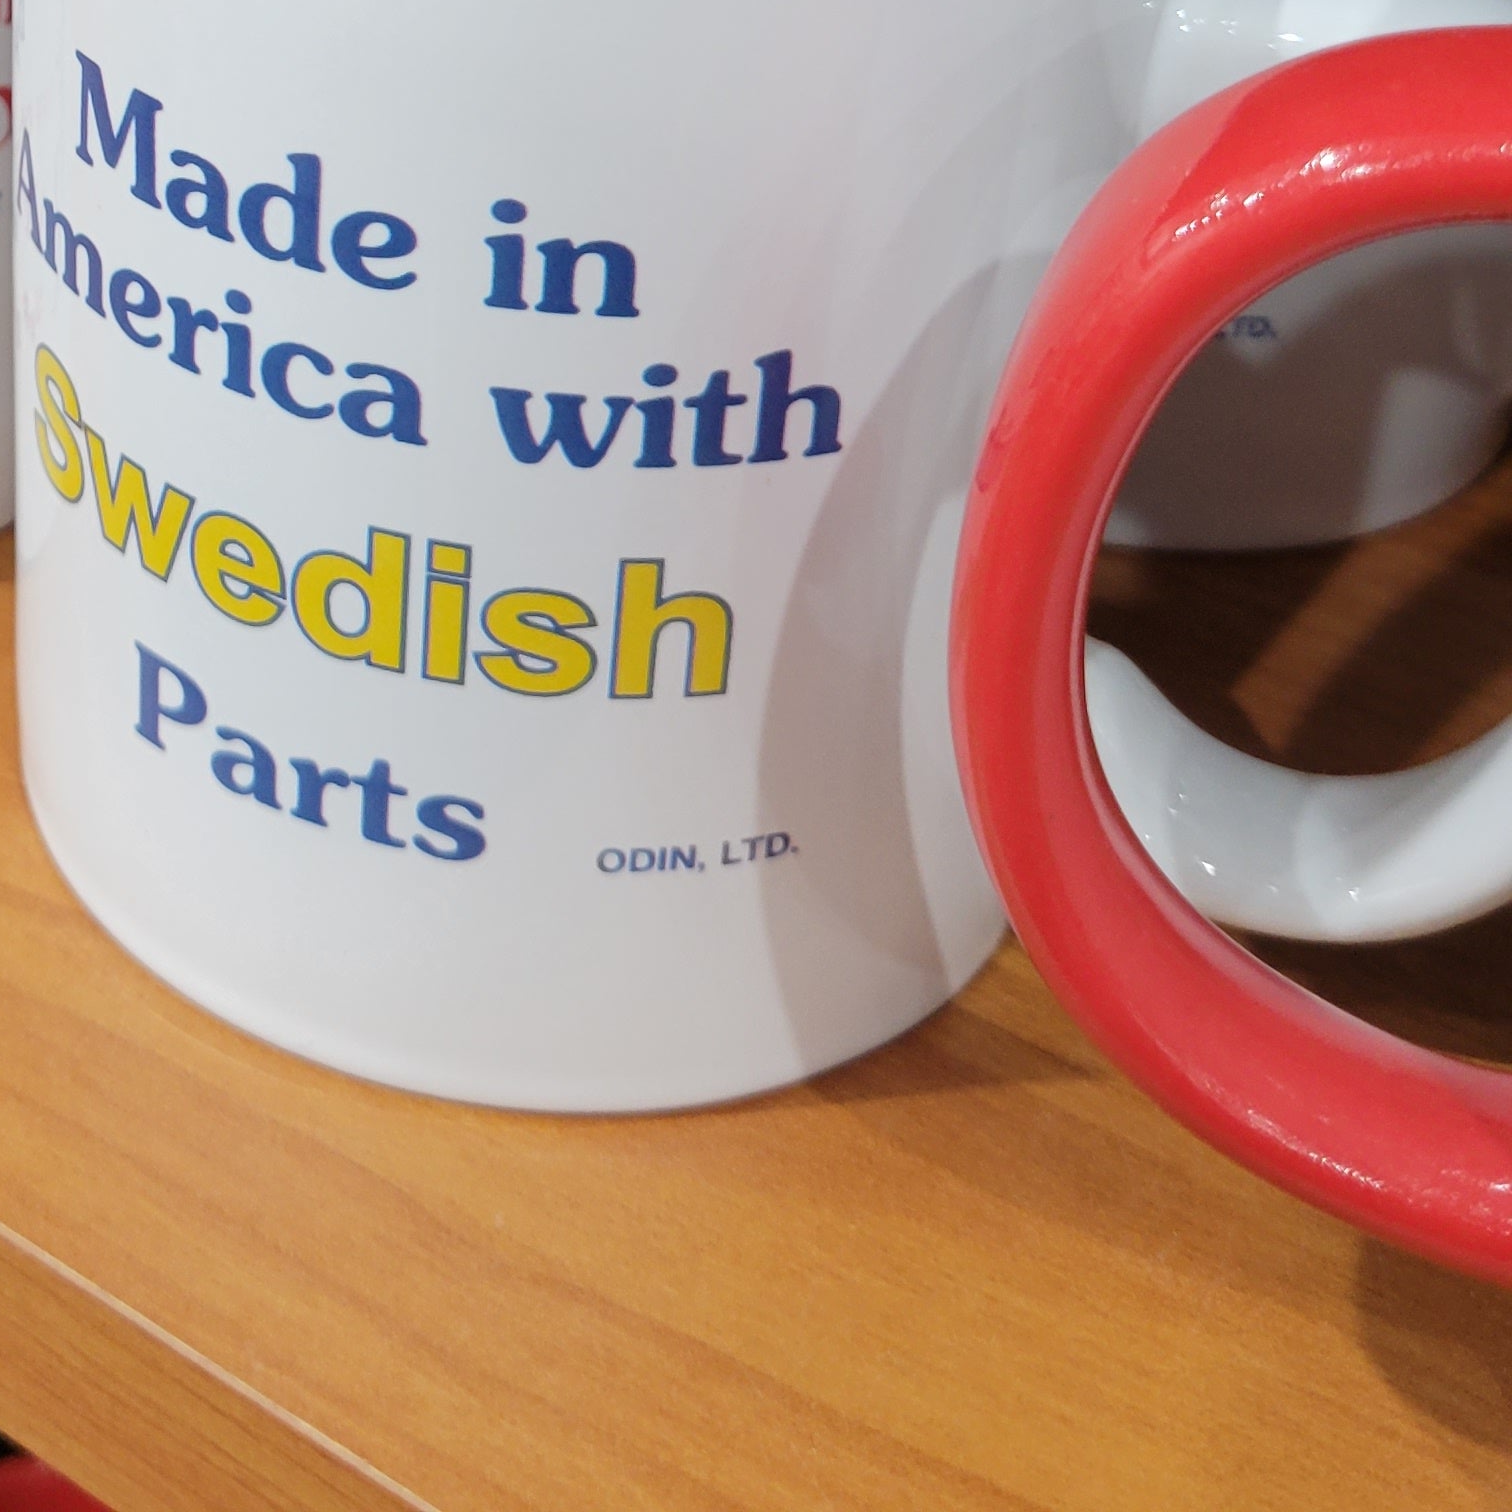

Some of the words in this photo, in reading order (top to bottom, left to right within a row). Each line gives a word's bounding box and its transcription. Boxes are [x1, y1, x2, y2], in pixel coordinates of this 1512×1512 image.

[16, 127, 428, 447] America
[489, 348, 843, 469] with
[75, 50, 418, 291] Made
[484, 198, 640, 318] in
[34, 343, 734, 700] Swedish
[134, 639, 487, 862] Parts
[596, 844, 708, 875] ODIN,
[721, 832, 800, 865] LTD.
